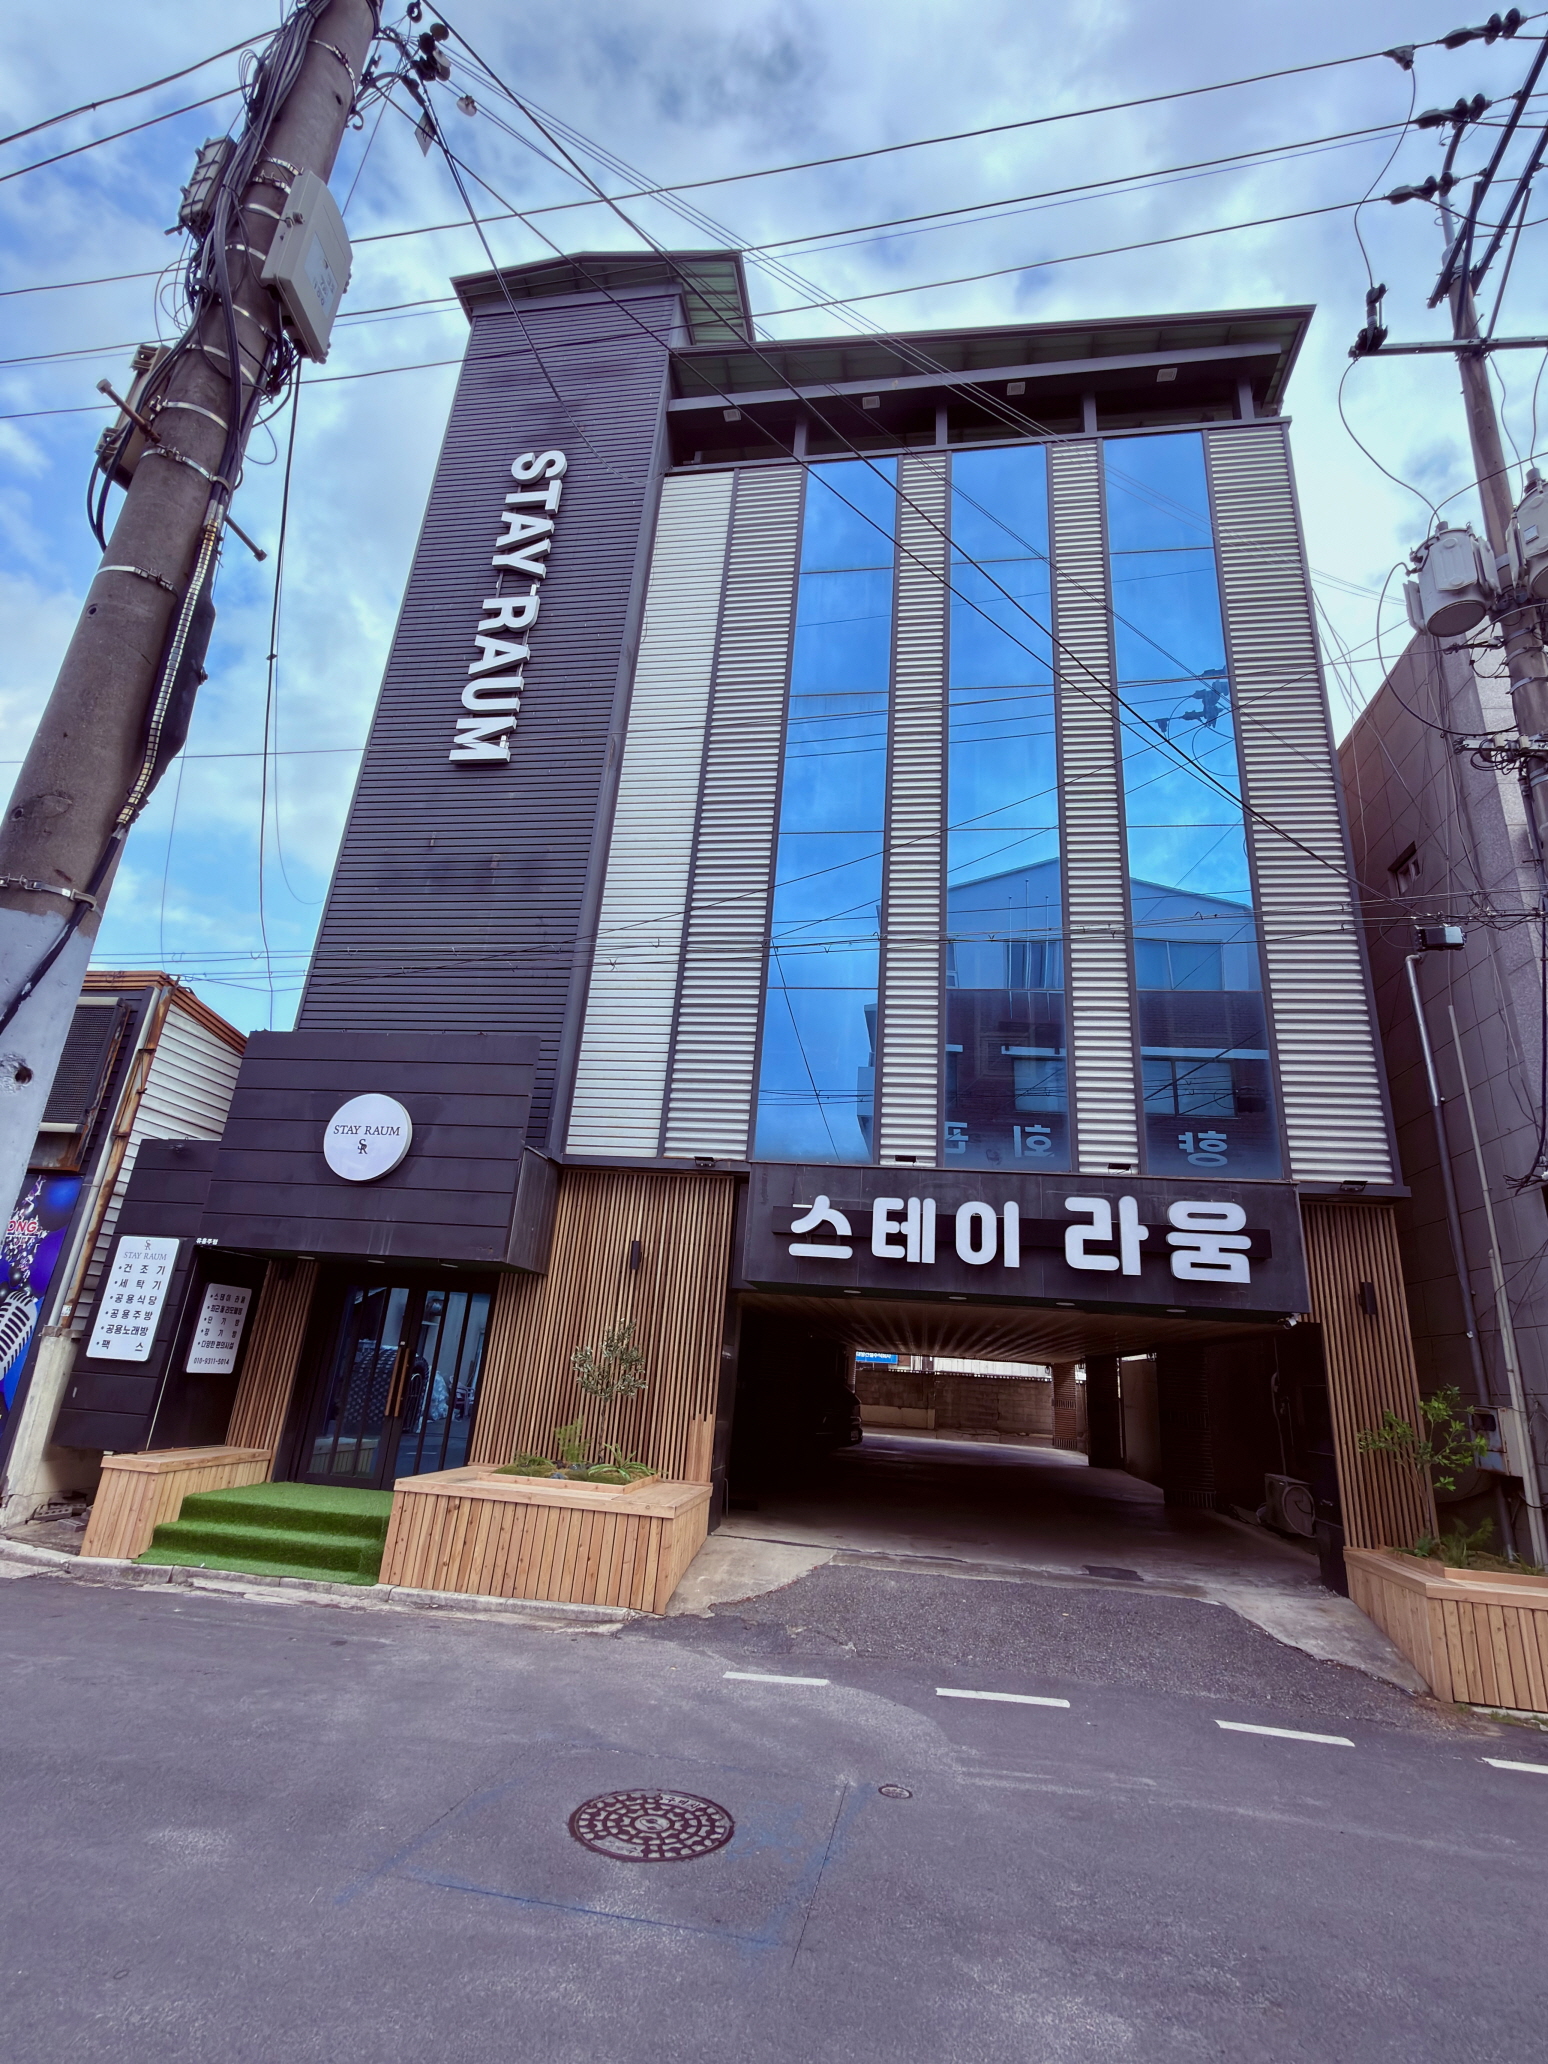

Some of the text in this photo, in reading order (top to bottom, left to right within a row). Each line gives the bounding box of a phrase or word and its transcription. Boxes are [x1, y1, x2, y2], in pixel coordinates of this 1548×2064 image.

[449, 449, 568, 764] STAY RAUM
[333, 1124, 401, 1136] STAY RAUM
[788, 1194, 1253, 1284] 스테이 라움
[123, 1251, 168, 1261] STAY RAUM
[105, 1324, 149, 1337] 공용노래방
[193, 1357, 230, 1365] 010-9311-5014
